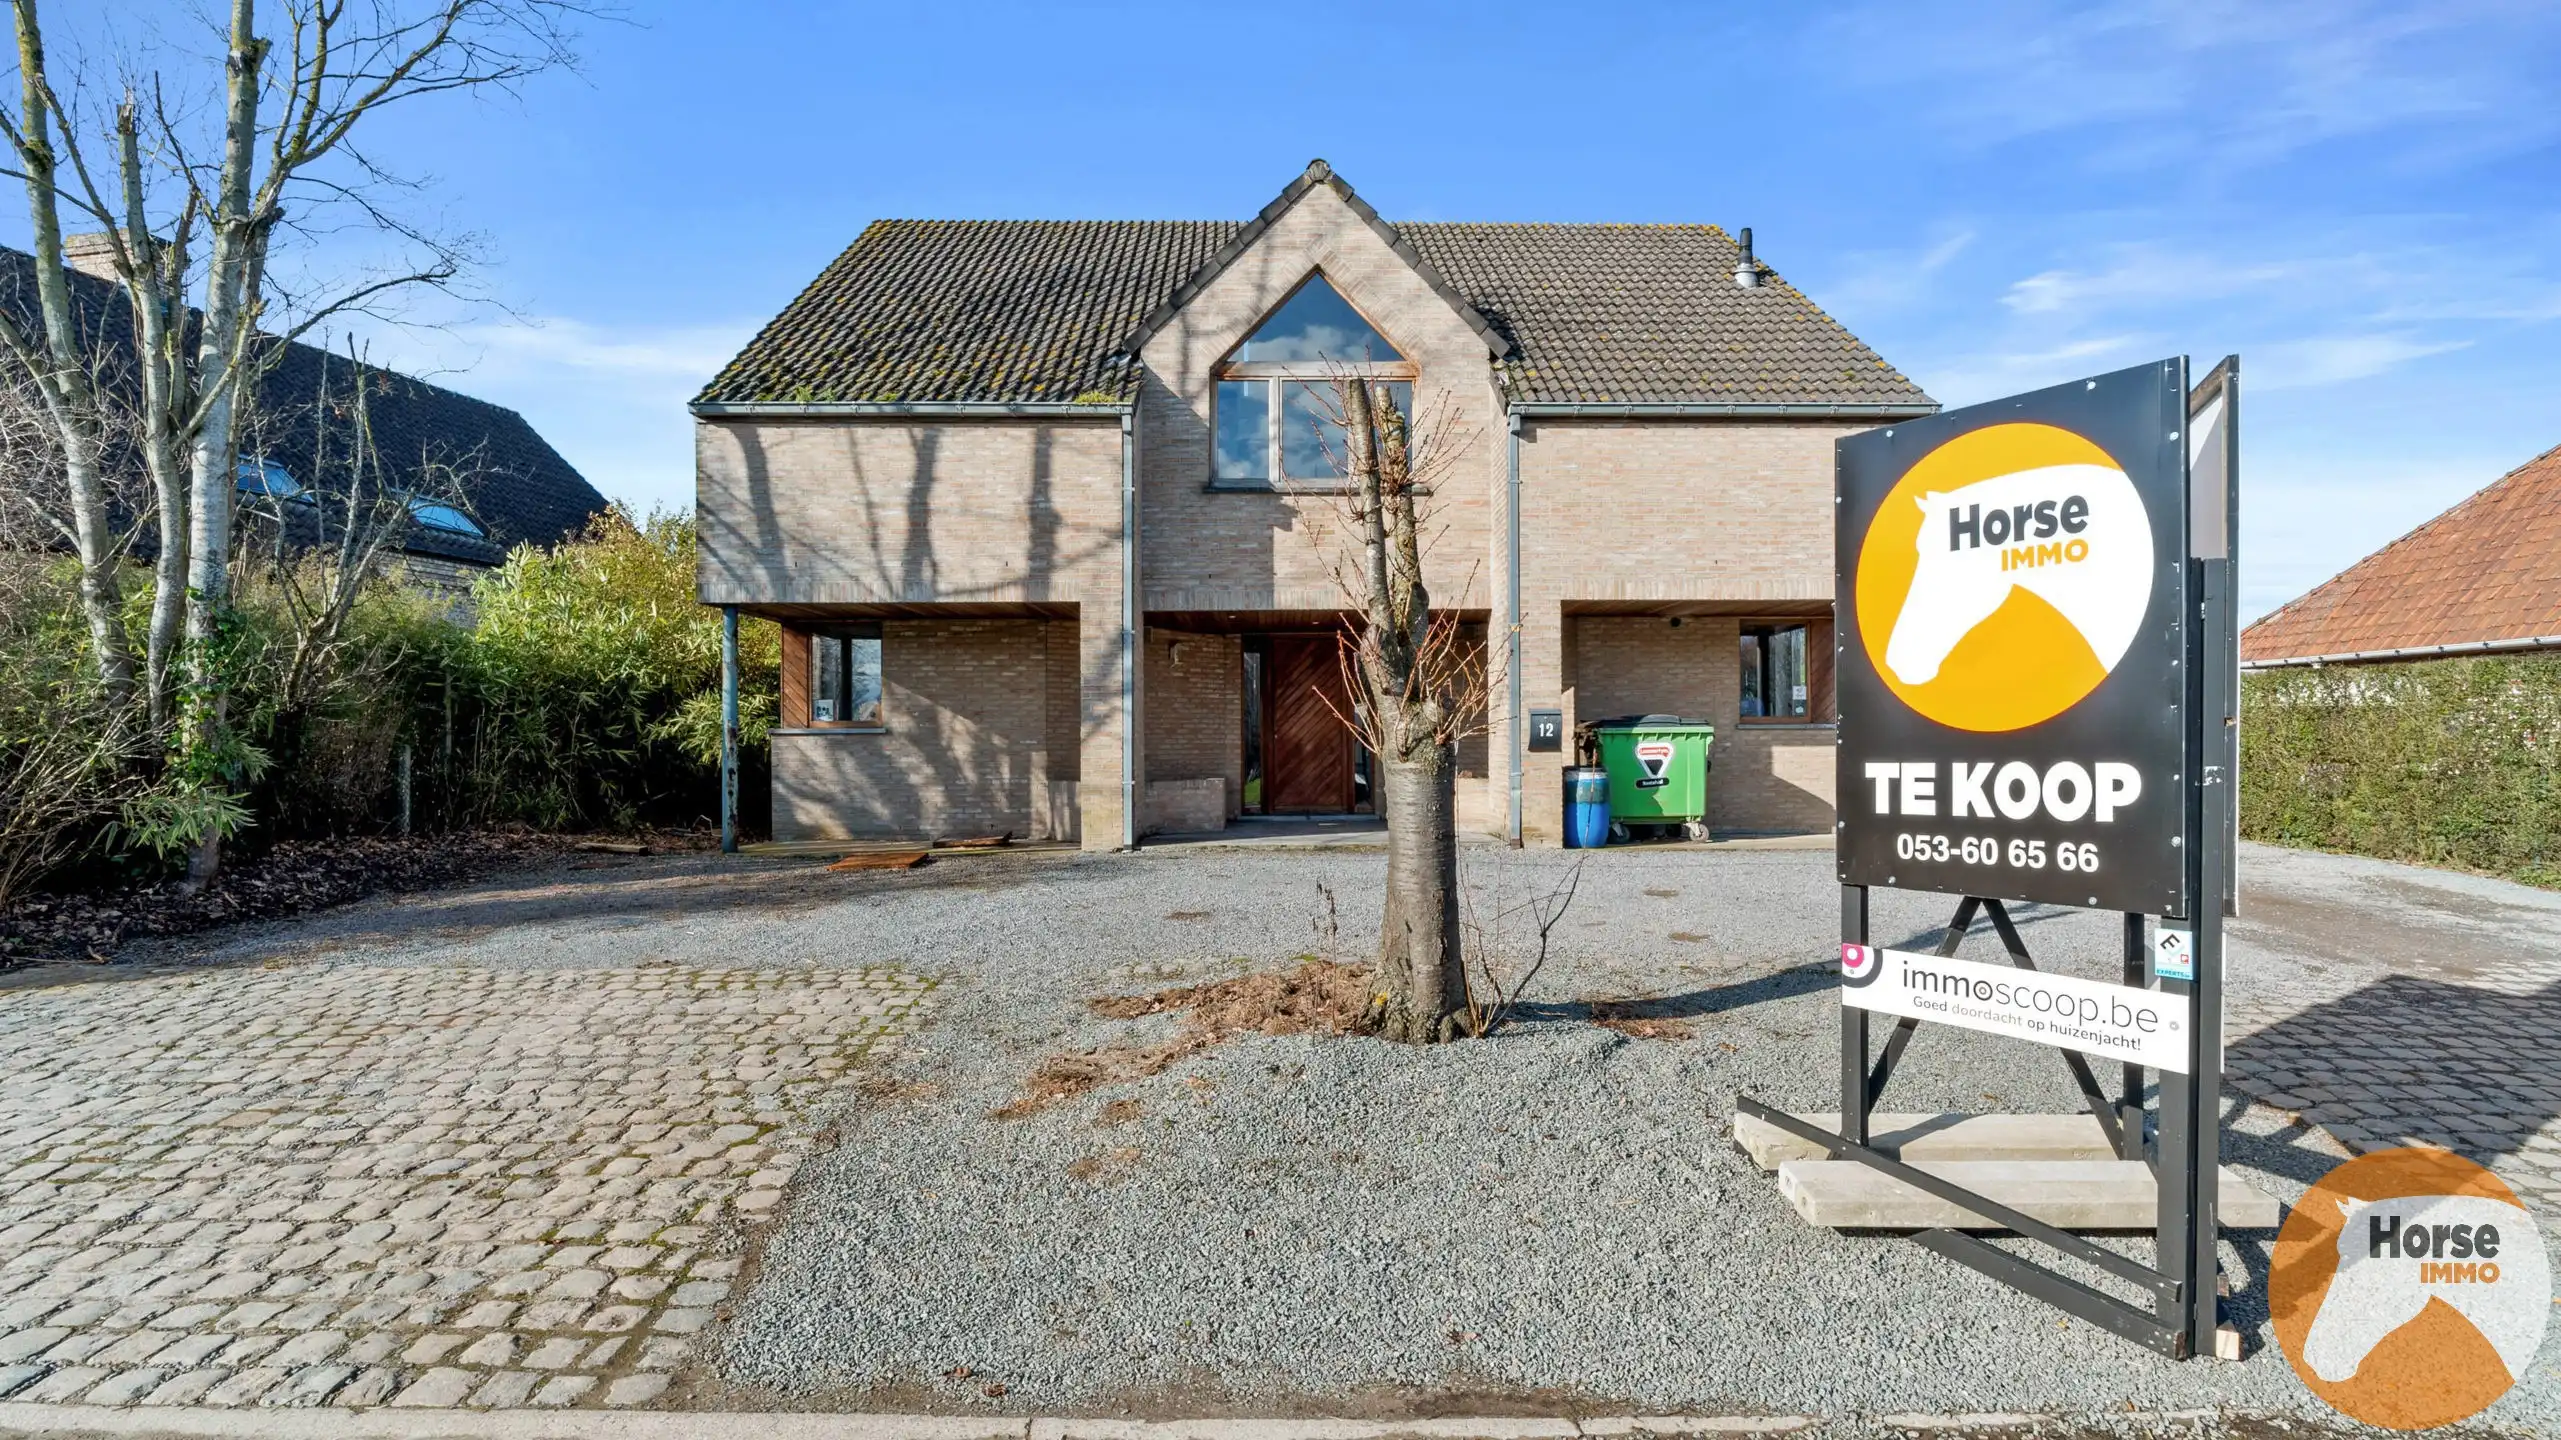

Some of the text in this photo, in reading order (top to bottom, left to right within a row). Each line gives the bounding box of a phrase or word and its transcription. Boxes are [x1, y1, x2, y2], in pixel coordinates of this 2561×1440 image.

[1949, 494, 2089, 551] Horse
[2001, 538, 2089, 571] IMMO
[1538, 723, 1554, 737] 12
[1865, 761, 2142, 822] TE KOOP
[1897, 833, 2099, 873] 053-60 65 66
[1903, 960, 2158, 1032] immoscoop.be
[1913, 995, 2141, 1051] Goed doordacht op huizenjacht!
